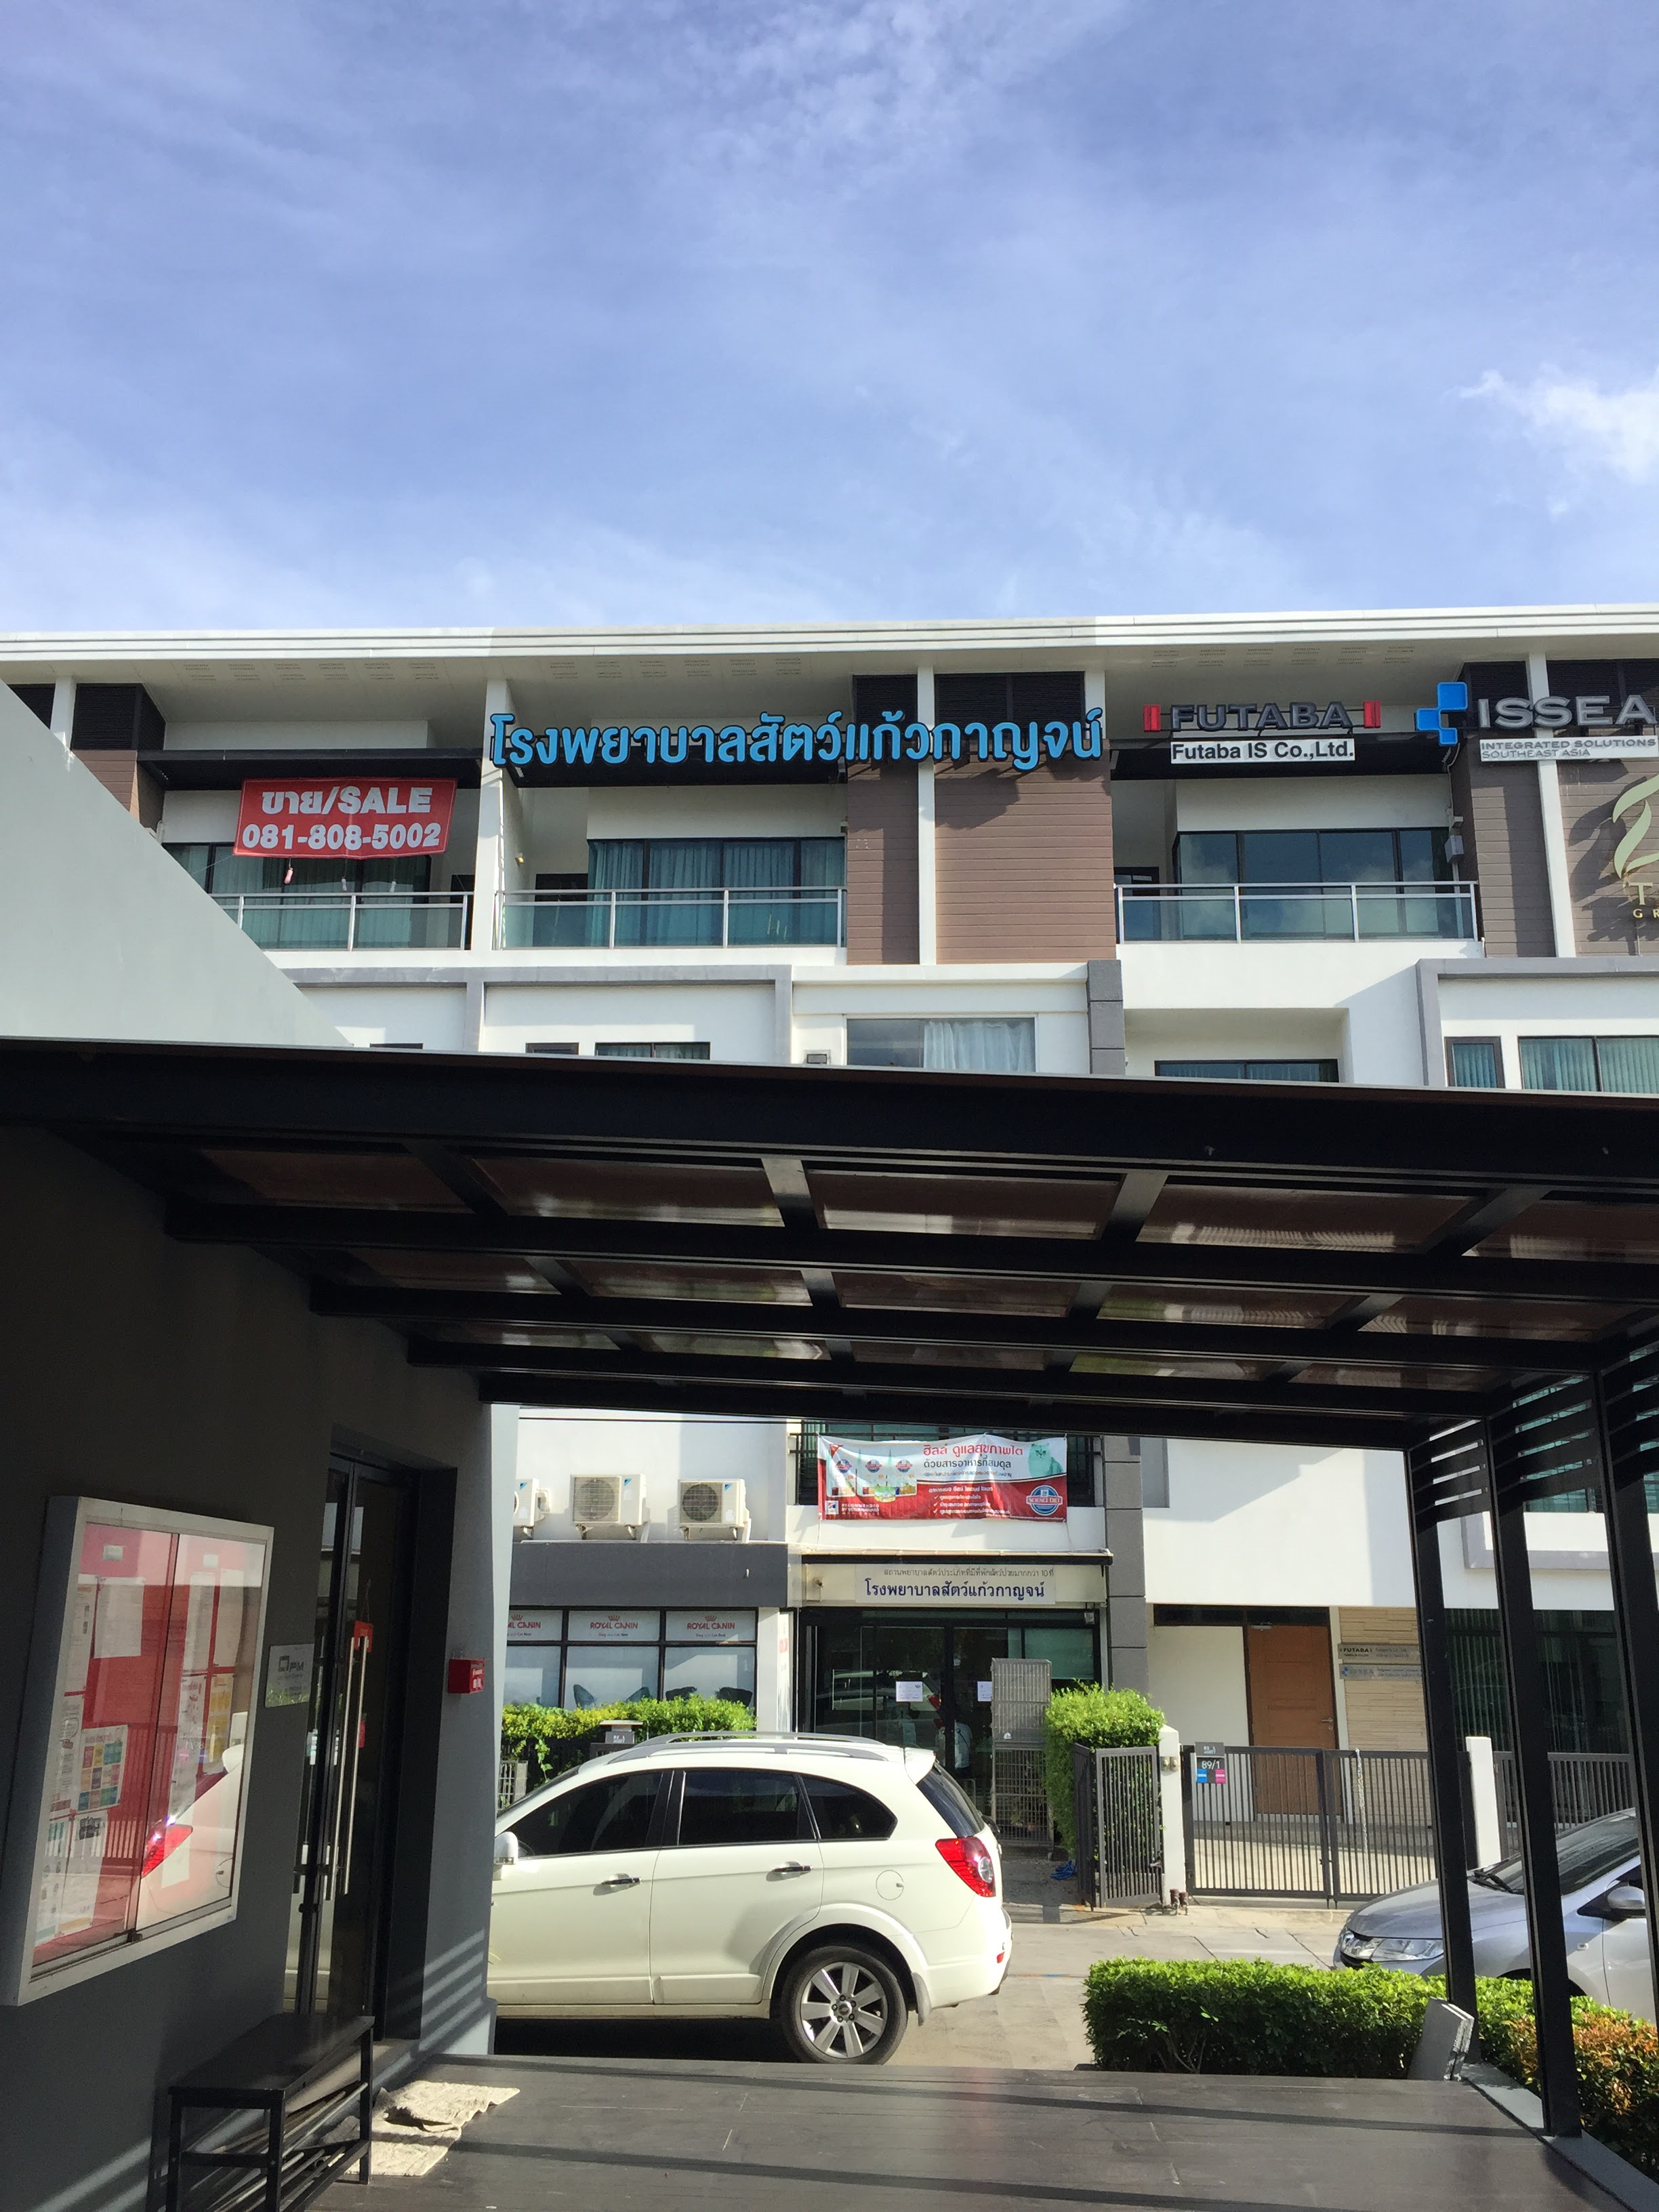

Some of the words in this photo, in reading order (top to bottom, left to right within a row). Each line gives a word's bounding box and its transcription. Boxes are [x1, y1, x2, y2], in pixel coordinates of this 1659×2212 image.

[1170, 701, 1353, 731] FUTABA
[1478, 695, 1658, 729] ISSEA
[490, 708, 1103, 771] โรงพยาบาลสัตว์แก้วกาญจน์
[1481, 741, 1570, 750] INTEGRATED
[1574, 739, 1656, 748] SOLUTIONS
[1172, 743, 1242, 760] Futaba
[1482, 750, 1559, 758] SOUTHEAST
[242, 821, 441, 851] 081-808-5002
[865, 1578, 1045, 1600] โรงพยาบาลสัตว์แก้วกาญจน์
[1202, 1759, 1220, 1769] 89/1
